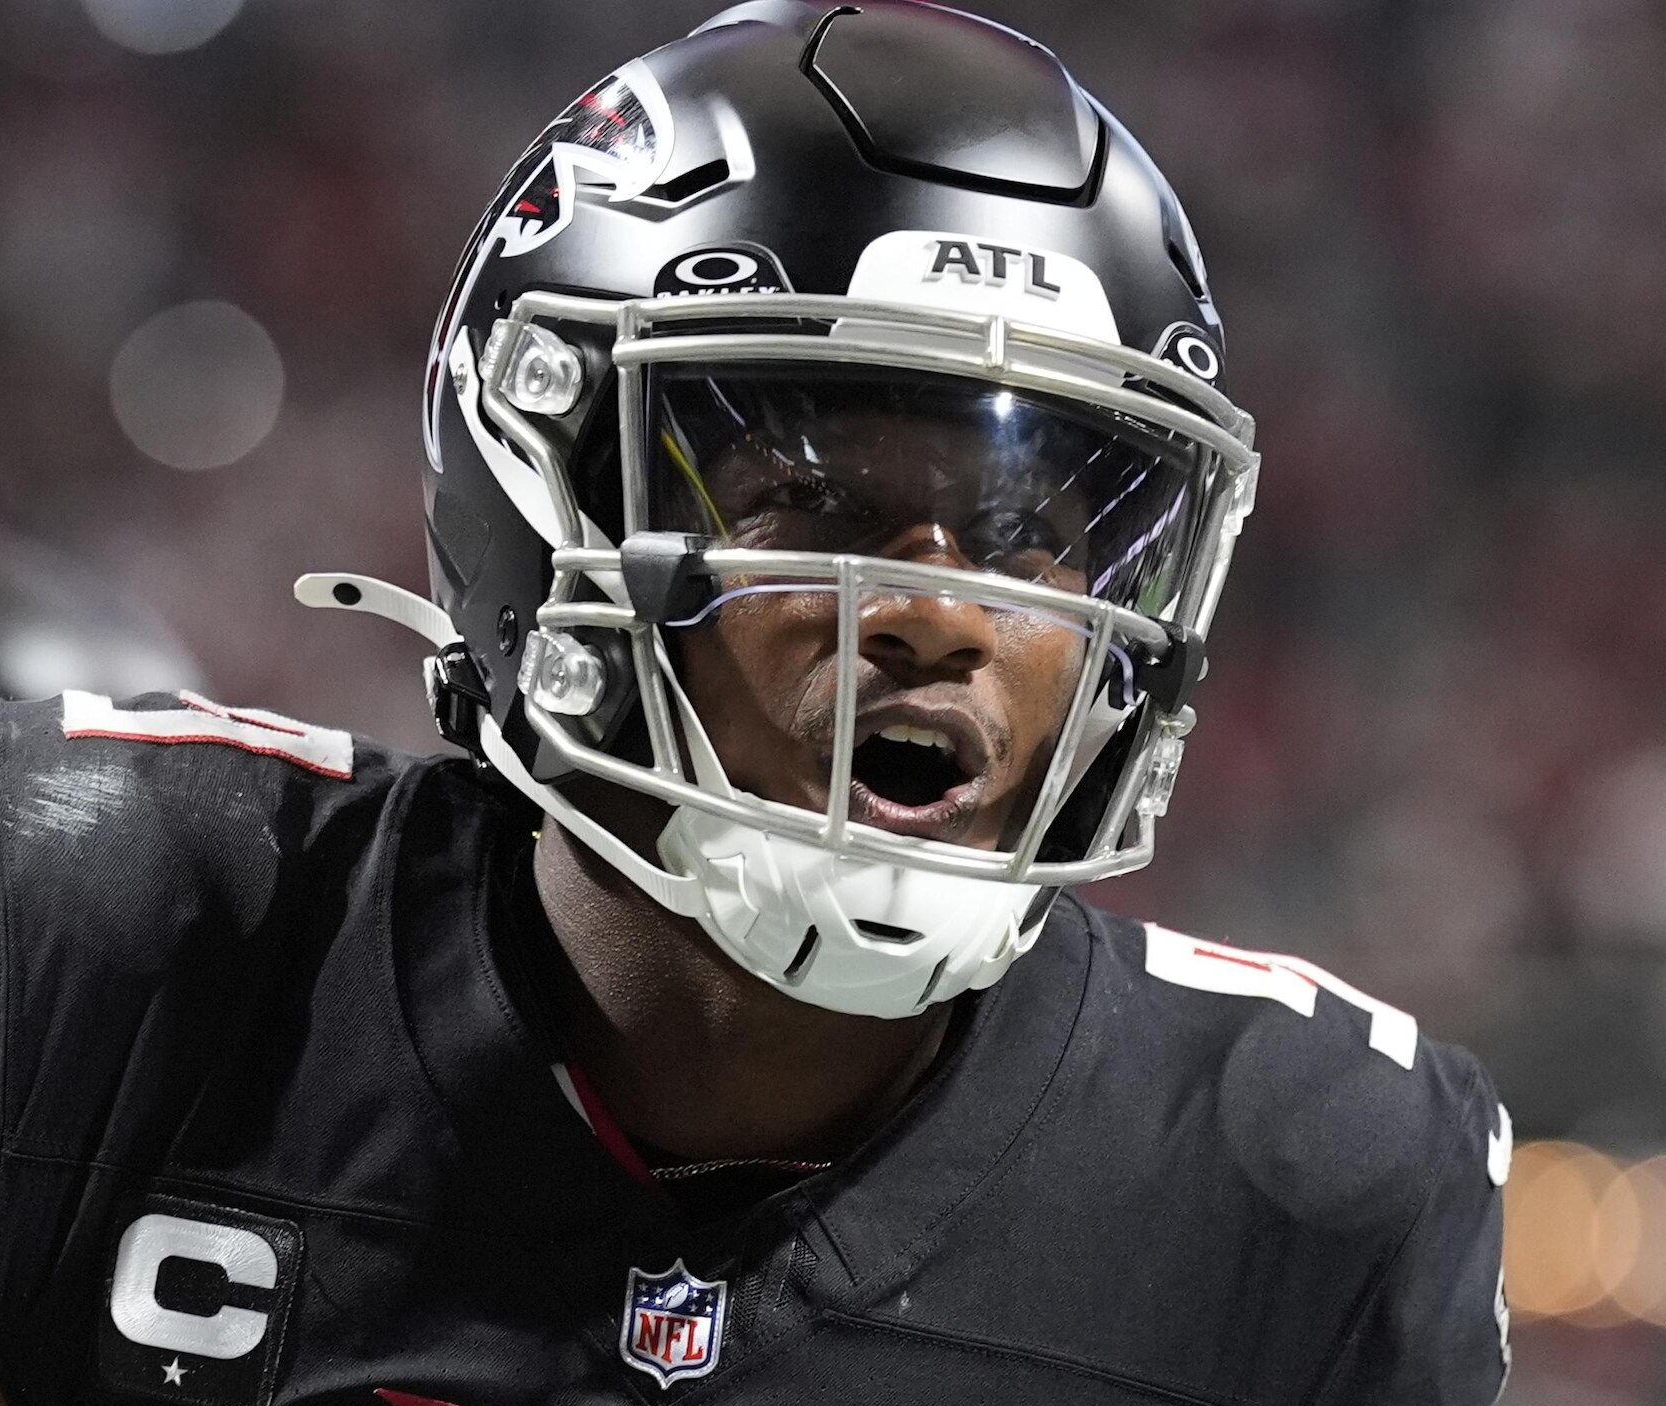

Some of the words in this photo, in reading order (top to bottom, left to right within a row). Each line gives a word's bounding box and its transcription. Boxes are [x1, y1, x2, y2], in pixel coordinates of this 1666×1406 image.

[925, 240, 1061, 297] ATL
[110, 1213, 279, 1360] C
[636, 1313, 703, 1364] NFL
